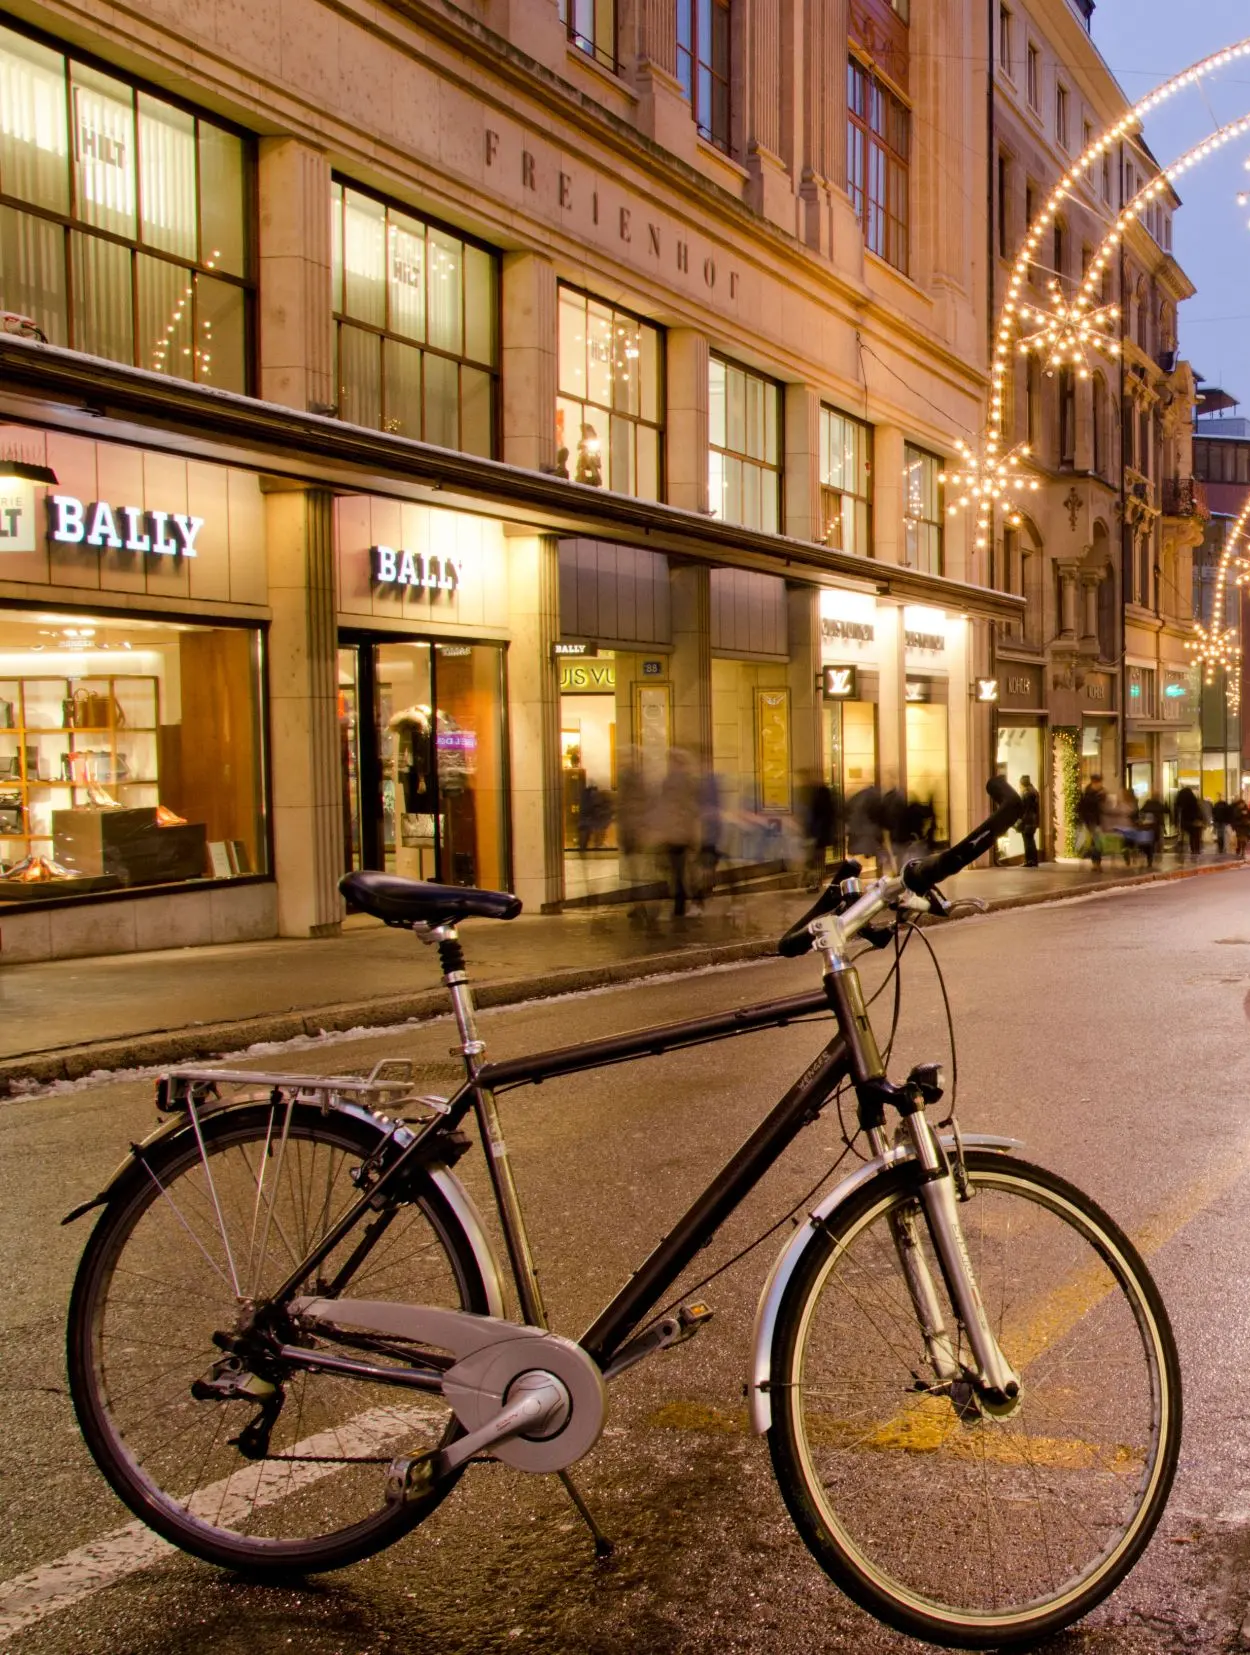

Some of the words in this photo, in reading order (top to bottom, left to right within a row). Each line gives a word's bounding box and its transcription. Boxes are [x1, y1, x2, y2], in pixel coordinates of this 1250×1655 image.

[485, 128, 740, 300] FREIENHOF
[51, 494, 205, 557] BALLY
[375, 544, 467, 590] BALLY
[555, 644, 586, 654] BALLY
